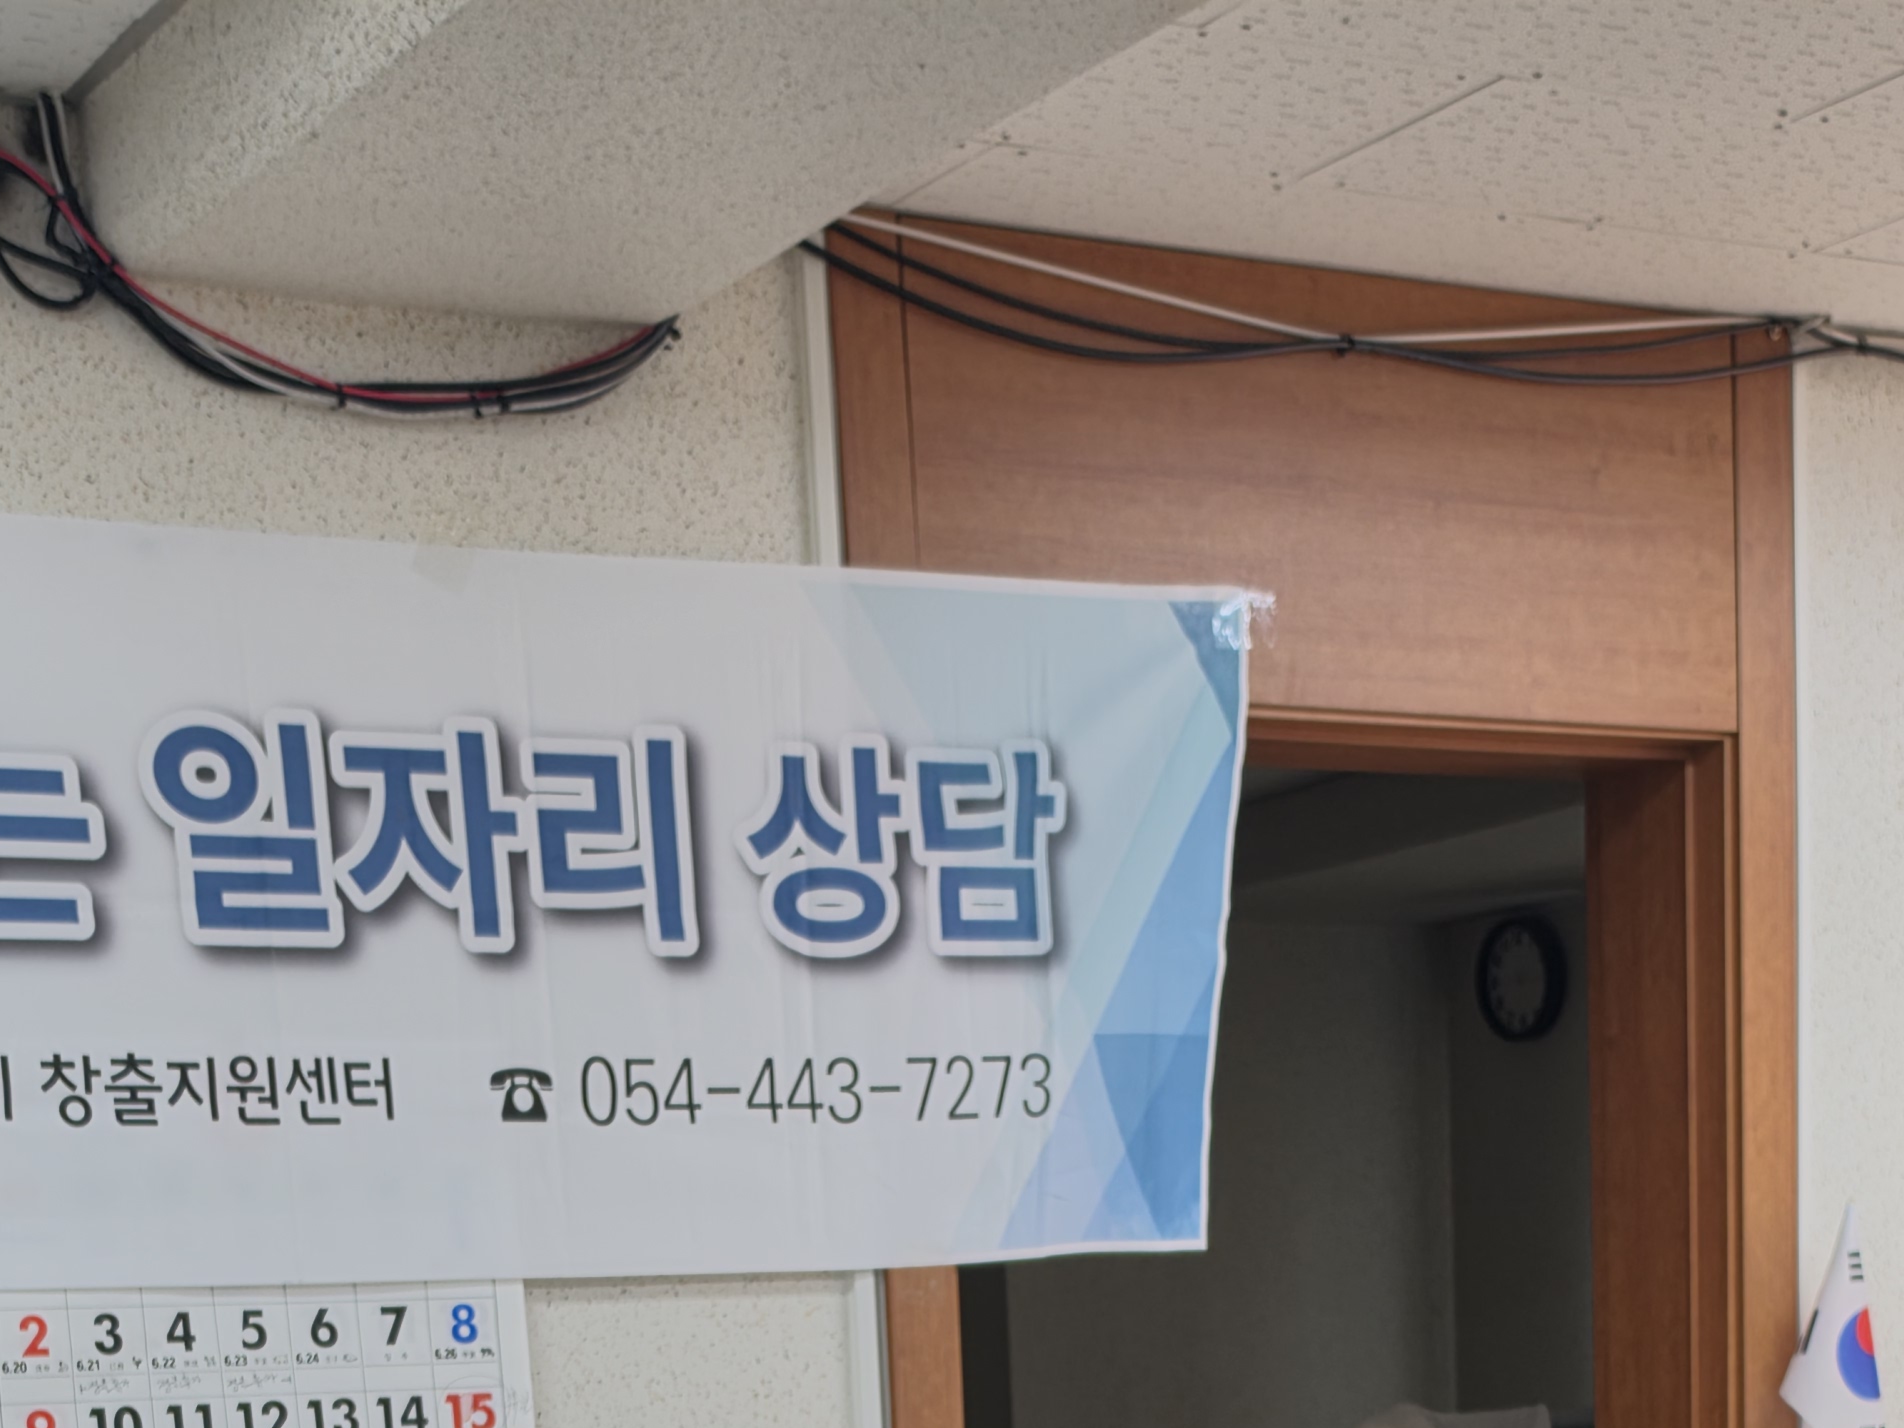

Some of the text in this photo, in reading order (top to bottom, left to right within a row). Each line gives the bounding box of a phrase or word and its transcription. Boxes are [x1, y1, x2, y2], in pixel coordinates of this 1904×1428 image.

[151, 719, 688, 942] 일자리
[748, 746, 1055, 944] 상담
[40, 1050, 395, 1128] 창출지원센터
[580, 1053, 1053, 1127] 054-443-7273
[2, 1348, 457, 1374] 6.20 6.21 6.22 6.23 6.24 6.26
[19, 1304, 478, 1358] 2 3 4 5 6 7 8
